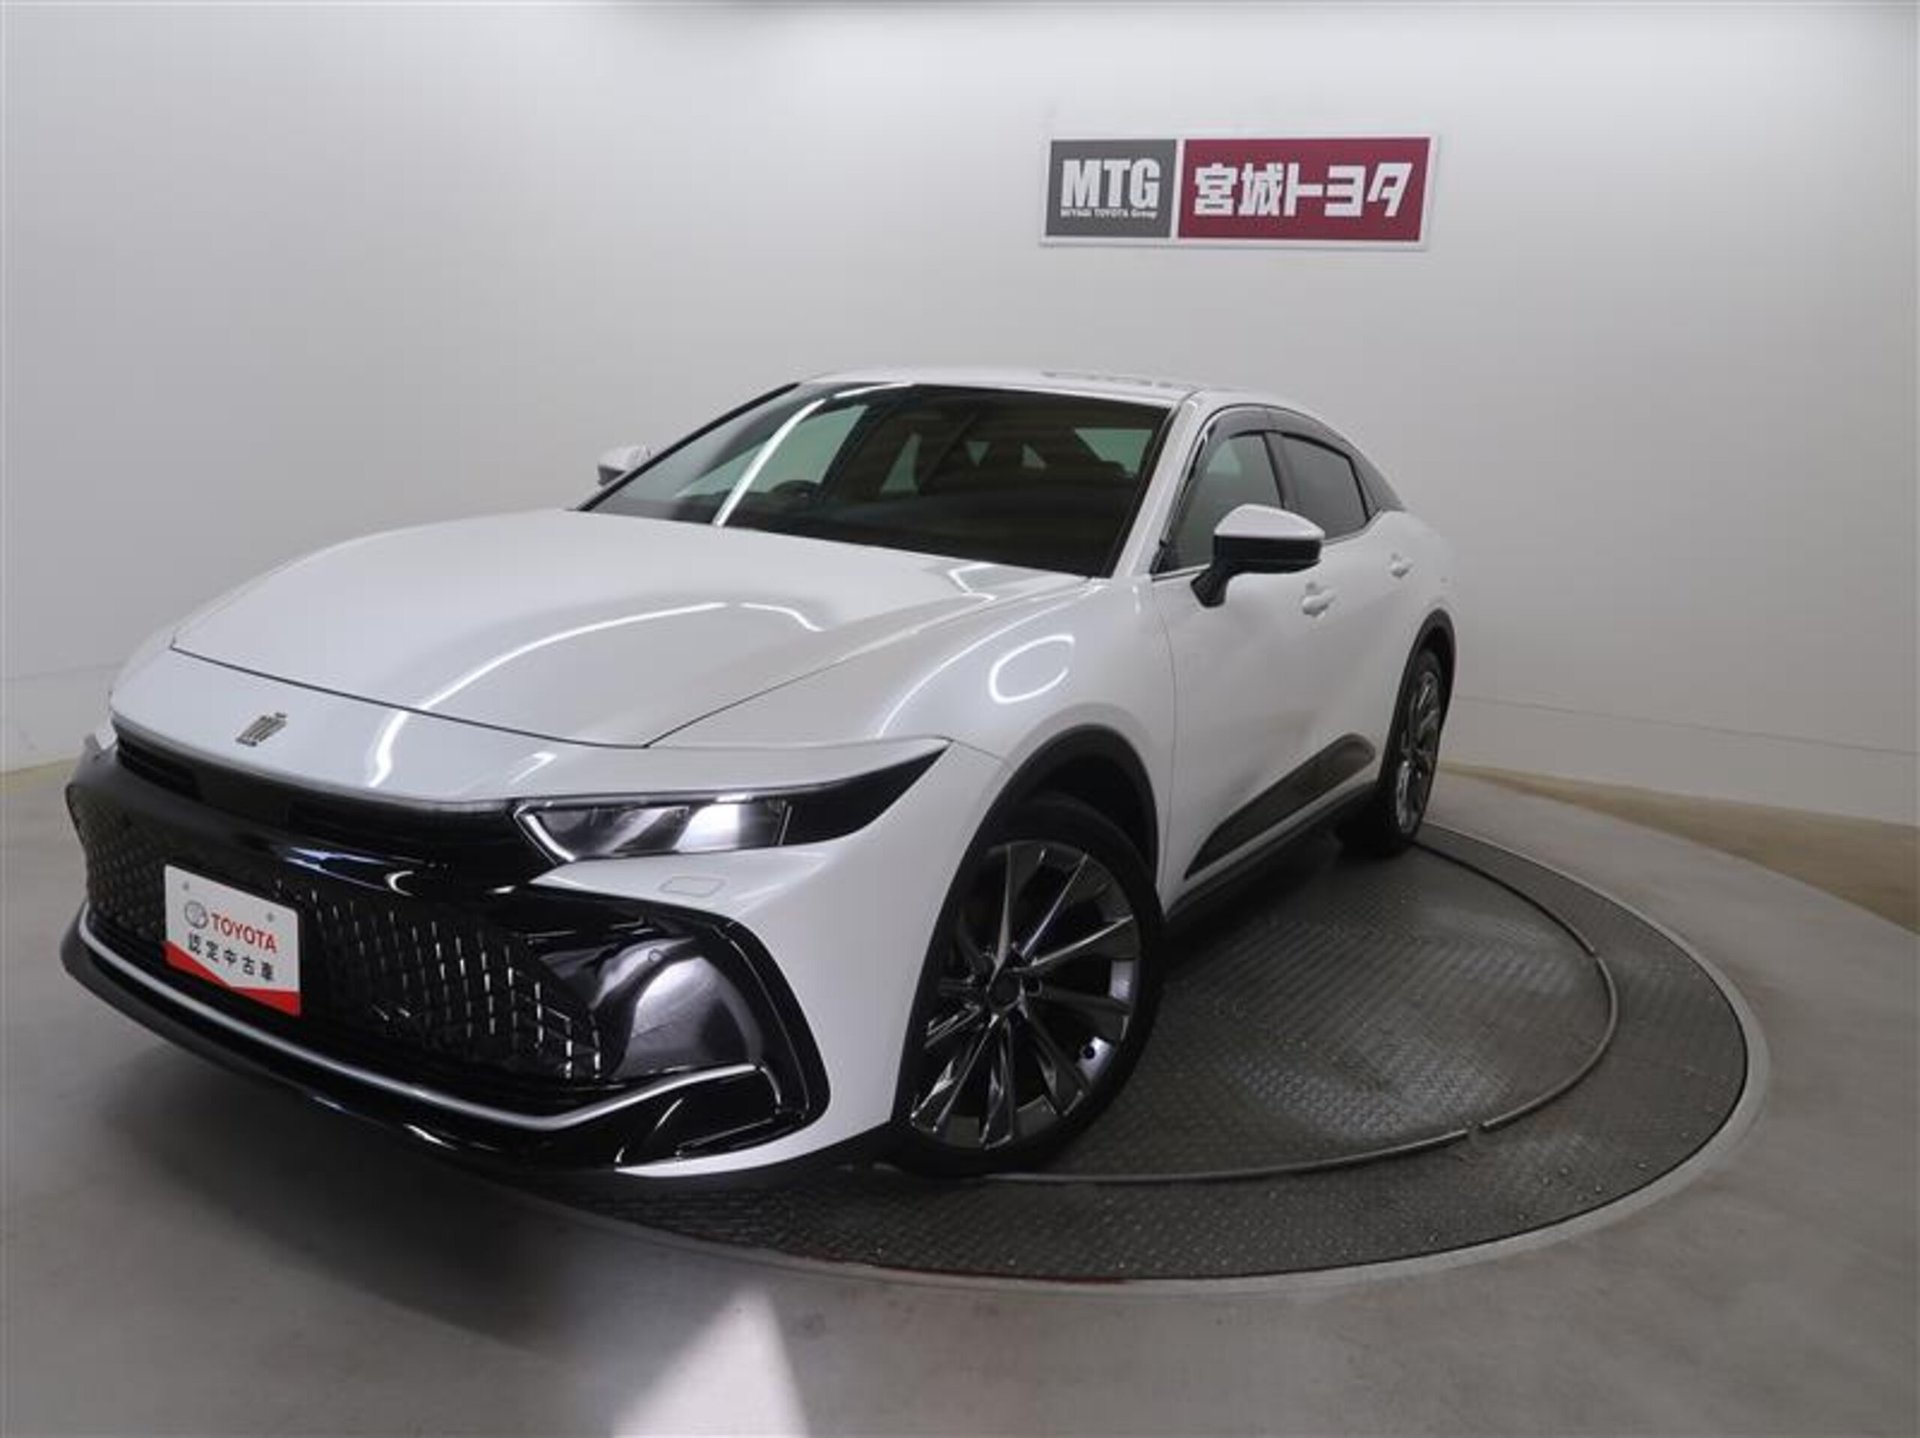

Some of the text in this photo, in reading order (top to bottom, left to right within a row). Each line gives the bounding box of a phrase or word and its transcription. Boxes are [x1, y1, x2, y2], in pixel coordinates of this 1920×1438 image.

[1061, 159, 1160, 208] MTG
[1194, 162, 1413, 217] 宮城トヨタ
[1094, 208, 1129, 218] TOYOTA
[1130, 209, 1158, 219] Group
[188, 932, 274, 981] 認定中古車
[211, 913, 277, 953] TOYOTA
